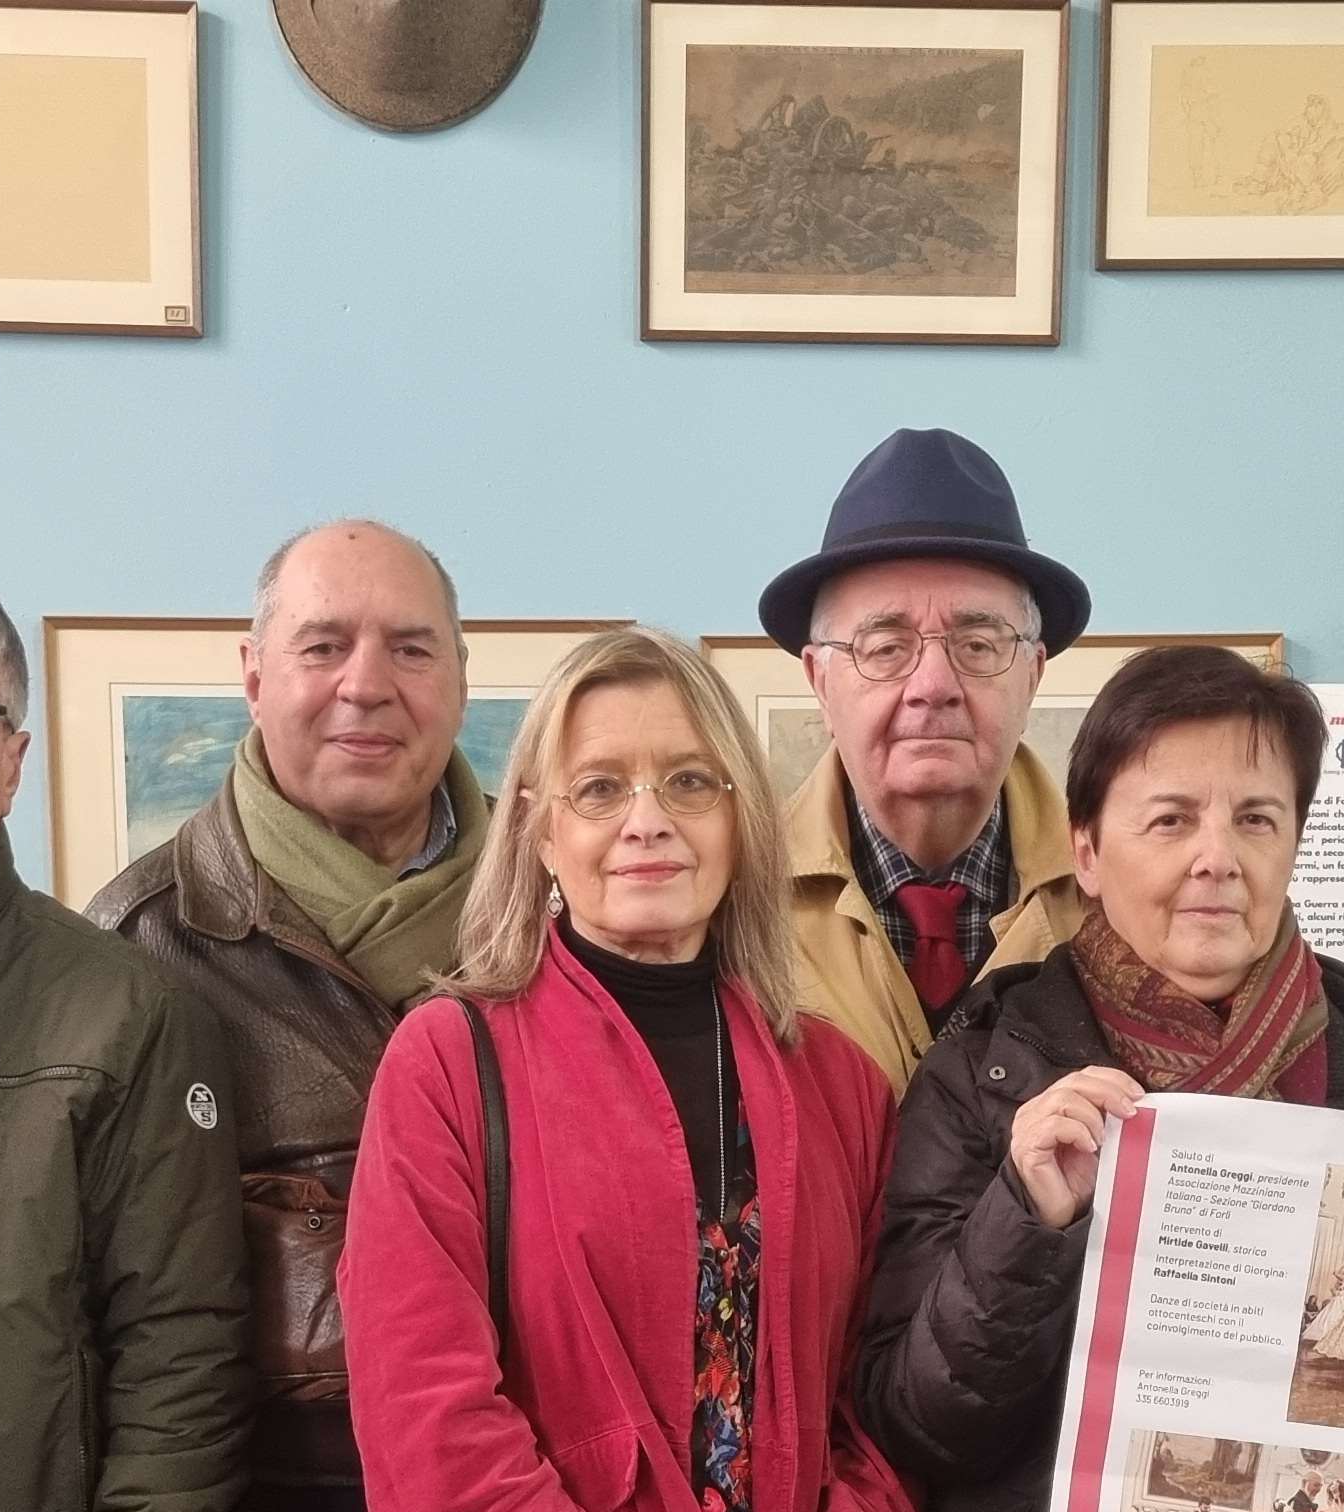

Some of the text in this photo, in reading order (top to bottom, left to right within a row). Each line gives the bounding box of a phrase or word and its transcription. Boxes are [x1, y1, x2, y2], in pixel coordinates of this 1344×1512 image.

[1324, 796, 1333, 805] di
[1304, 899, 1339, 908] Guerra
[1171, 1149, 1215, 1163] Saluto di
[1170, 1163, 1218, 1177] Antonella
[1257, 1175, 1309, 1188] presidente
[1168, 1176, 1286, 1199] Associazione Mazziniana
[1166, 1190, 1202, 1203] Italiana
[1210, 1195, 1248, 1209] Sezione
[1199, 1208, 1209, 1217] di
[1161, 1222, 1223, 1238] Intervento di
[1159, 1235, 1194, 1248] Mirtide
[1233, 1246, 1267, 1257] storica
[1156, 1254, 1231, 1272] Interpretazione
[1233, 1264, 1242, 1273] di
[1154, 1267, 1236, 1286] Raffaella Sintoni
[1150, 1294, 1180, 1306] Danze
[1182, 1298, 1191, 1308] di
[1230, 1304, 1240, 1314] in
[1241, 1305, 1264, 1316] abiti
[1148, 1309, 1244, 1327] ottocenteschi con il
[1147, 1322, 1222, 1338] coinvolgimento
[1223, 1330, 1238, 1340] del
[1139, 1369, 1155, 1379] Per
[1137, 1382, 1210, 1400] Antonella Greggi
